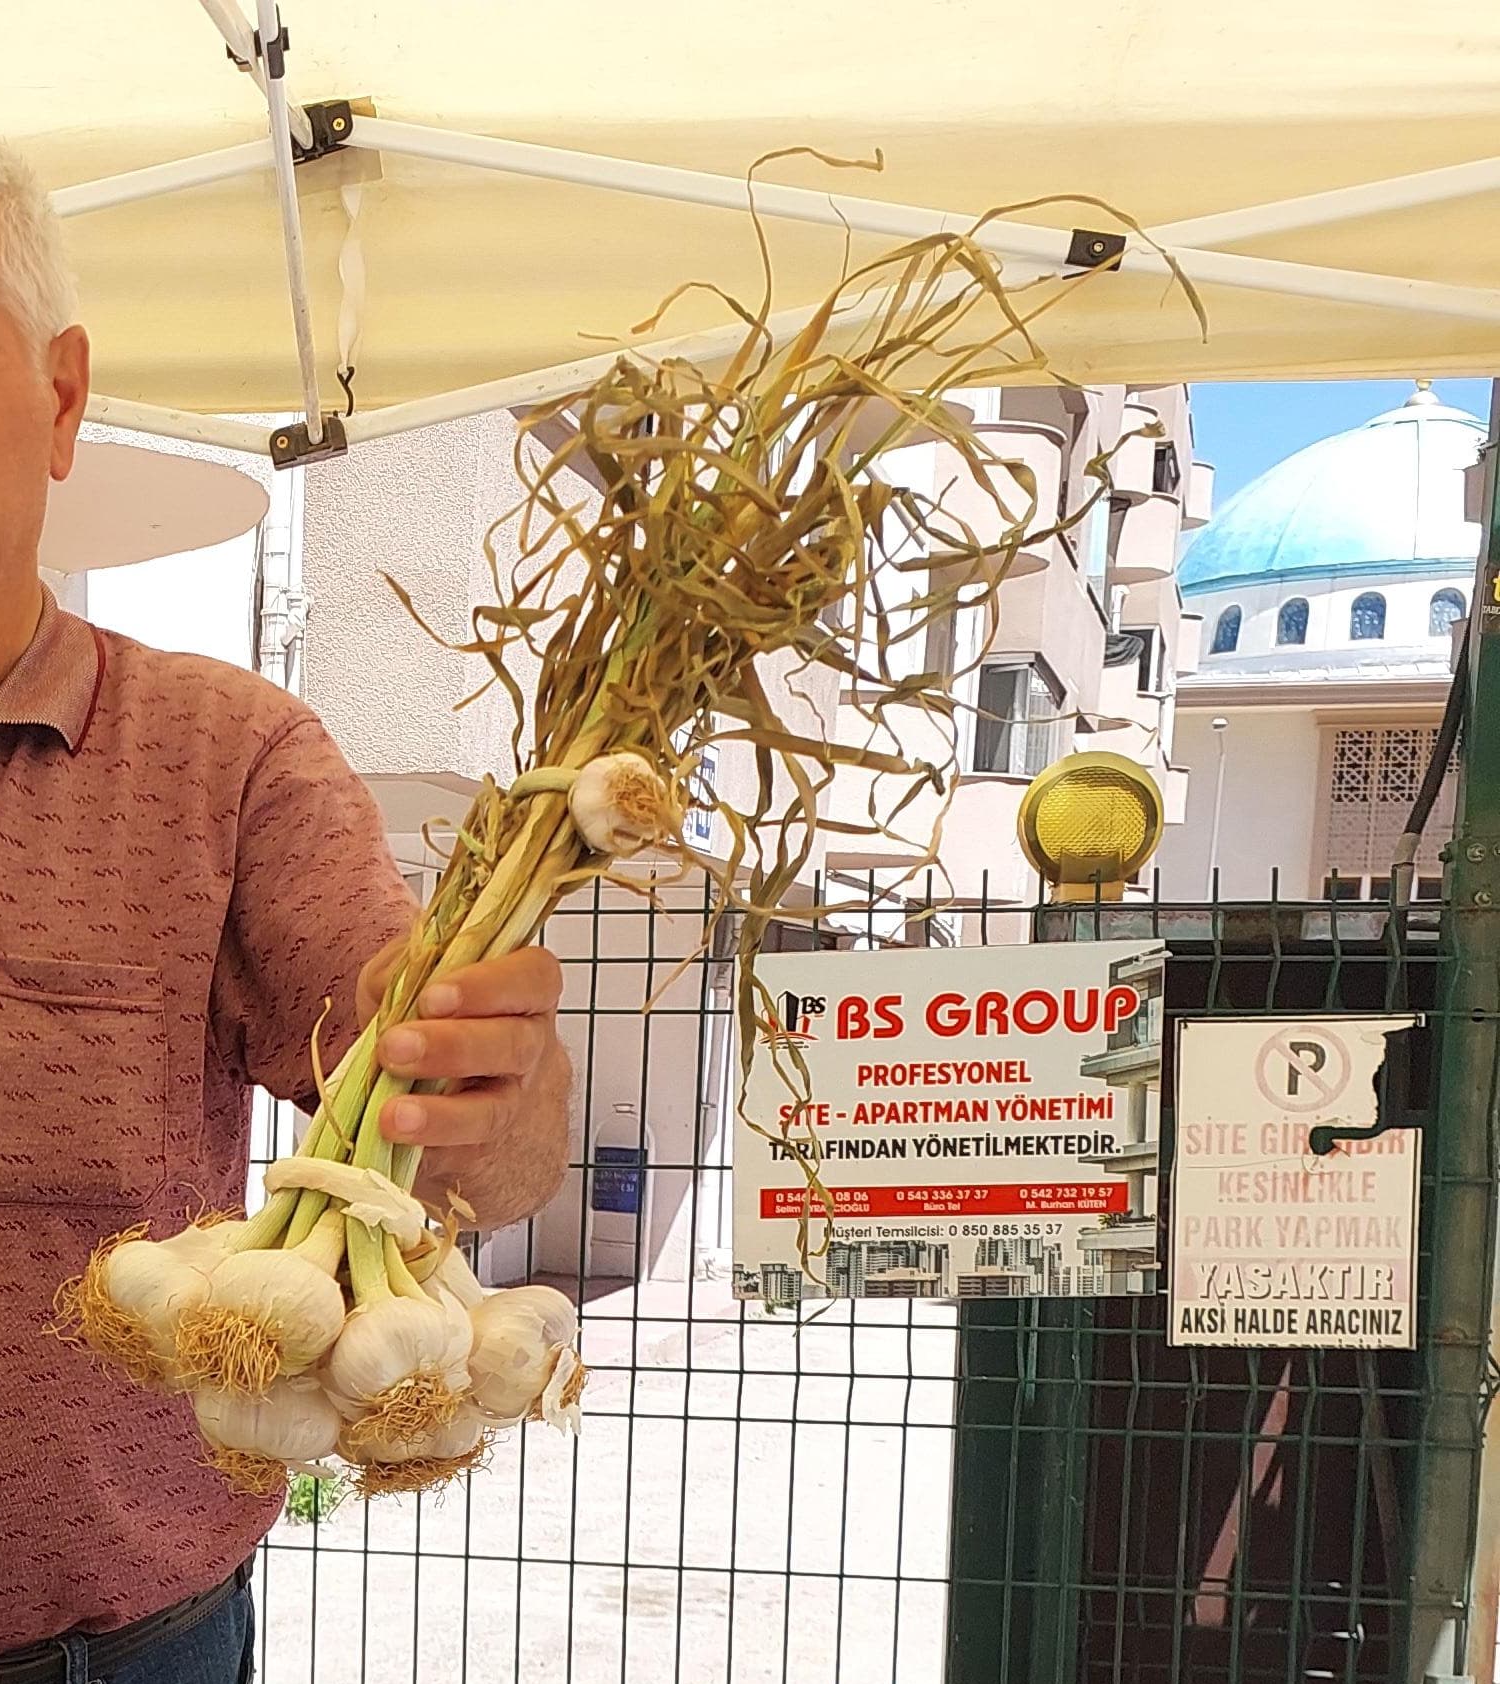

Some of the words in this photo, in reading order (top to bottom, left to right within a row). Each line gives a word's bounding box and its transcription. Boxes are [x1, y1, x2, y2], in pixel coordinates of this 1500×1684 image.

[801, 996, 827, 1015] BS
[837, 995, 904, 1040] BS
[925, 986, 1139, 1036] GROUP
[857, 1060, 1032, 1087] PROFESYONEL
[853, 1098, 988, 1126] APARTMAN
[996, 1092, 1114, 1122] YÖNETİMİ
[769, 1138, 907, 1161] TARAFINDAN
[912, 1130, 1121, 1158] YÖNETİLMEKTEDİR.
[1185, 1116, 1247, 1155] SİTE
[897, 1190, 904, 1200] 0
[908, 1190, 929, 1201] 543
[932, 1189, 952, 1200] 336
[956, 1189, 970, 1200] 37
[974, 1189, 989, 1199] 37
[1020, 1188, 1027, 1199] 0
[1031, 1188, 1053, 1199] 542
[1056, 1188, 1078, 1198] 732
[1083, 1187, 1095, 1198] 19
[1098, 1187, 1113, 1197] 57
[1218, 1164, 1377, 1204] KESİNLİKLE
[949, 1225, 958, 1237] 0
[962, 1225, 988, 1237] 850
[992, 1224, 1019, 1237] 885
[1023, 1224, 1041, 1236] 35
[1045, 1223, 1063, 1236] 37
[1184, 1215, 1264, 1250] PARK
[1275, 1215, 1402, 1250] YAPMAK
[1193, 1262, 1394, 1301] YASAKTIR
[1180, 1303, 1227, 1336] AKSİ
[1234, 1307, 1299, 1336] HALDE
[1305, 1308, 1404, 1336] ARACINIZ
